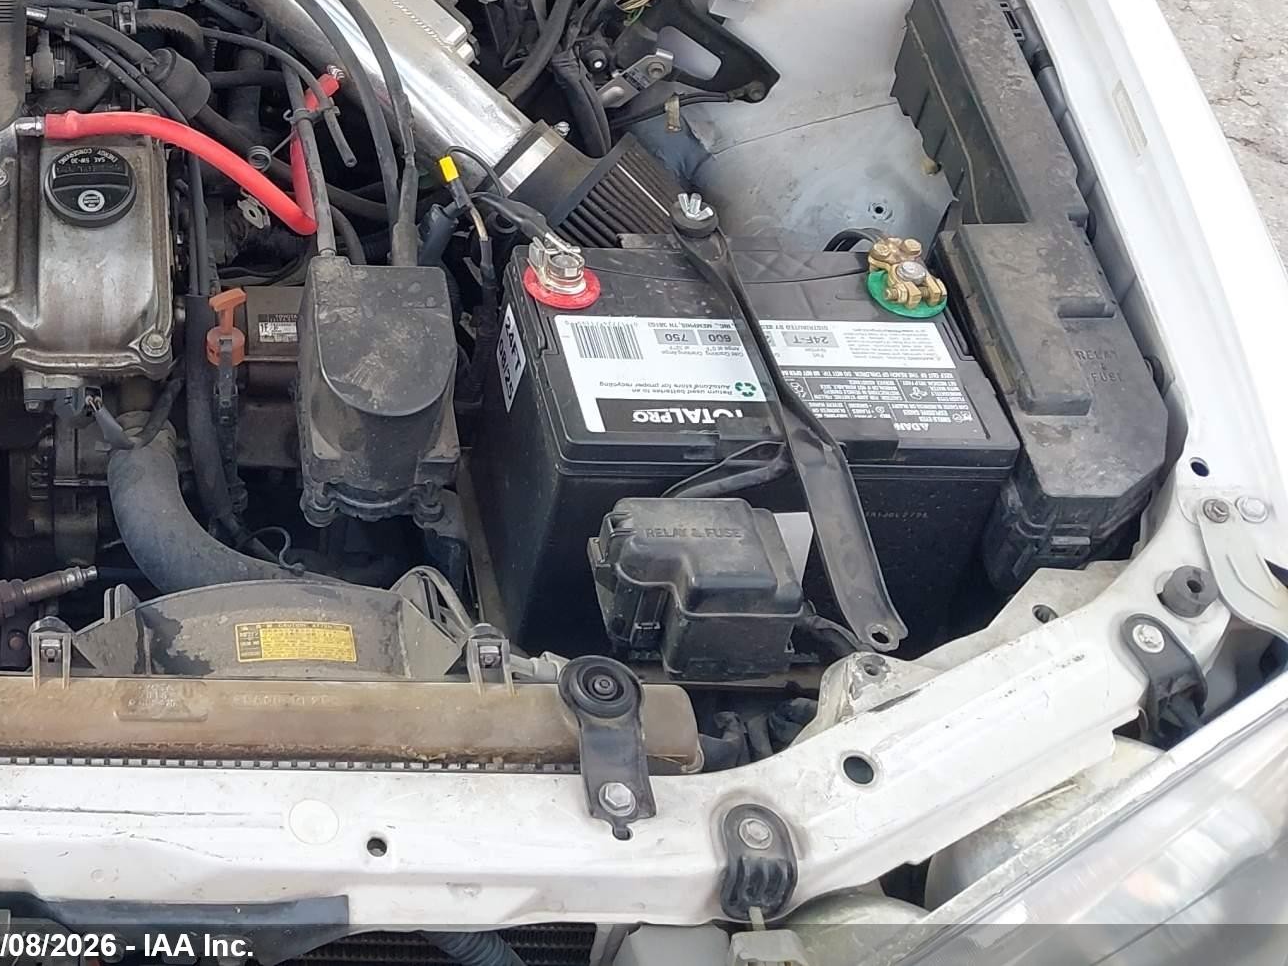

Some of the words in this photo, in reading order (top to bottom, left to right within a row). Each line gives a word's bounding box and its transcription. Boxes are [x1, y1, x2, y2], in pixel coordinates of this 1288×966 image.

[94, 156, 106, 164] SAE
[664, 333, 689, 342] 750
[708, 333, 732, 343] 600
[793, 334, 829, 345] 24F-T
[645, 527, 687, 539] RELAY
[704, 527, 743, 539] FUSE
